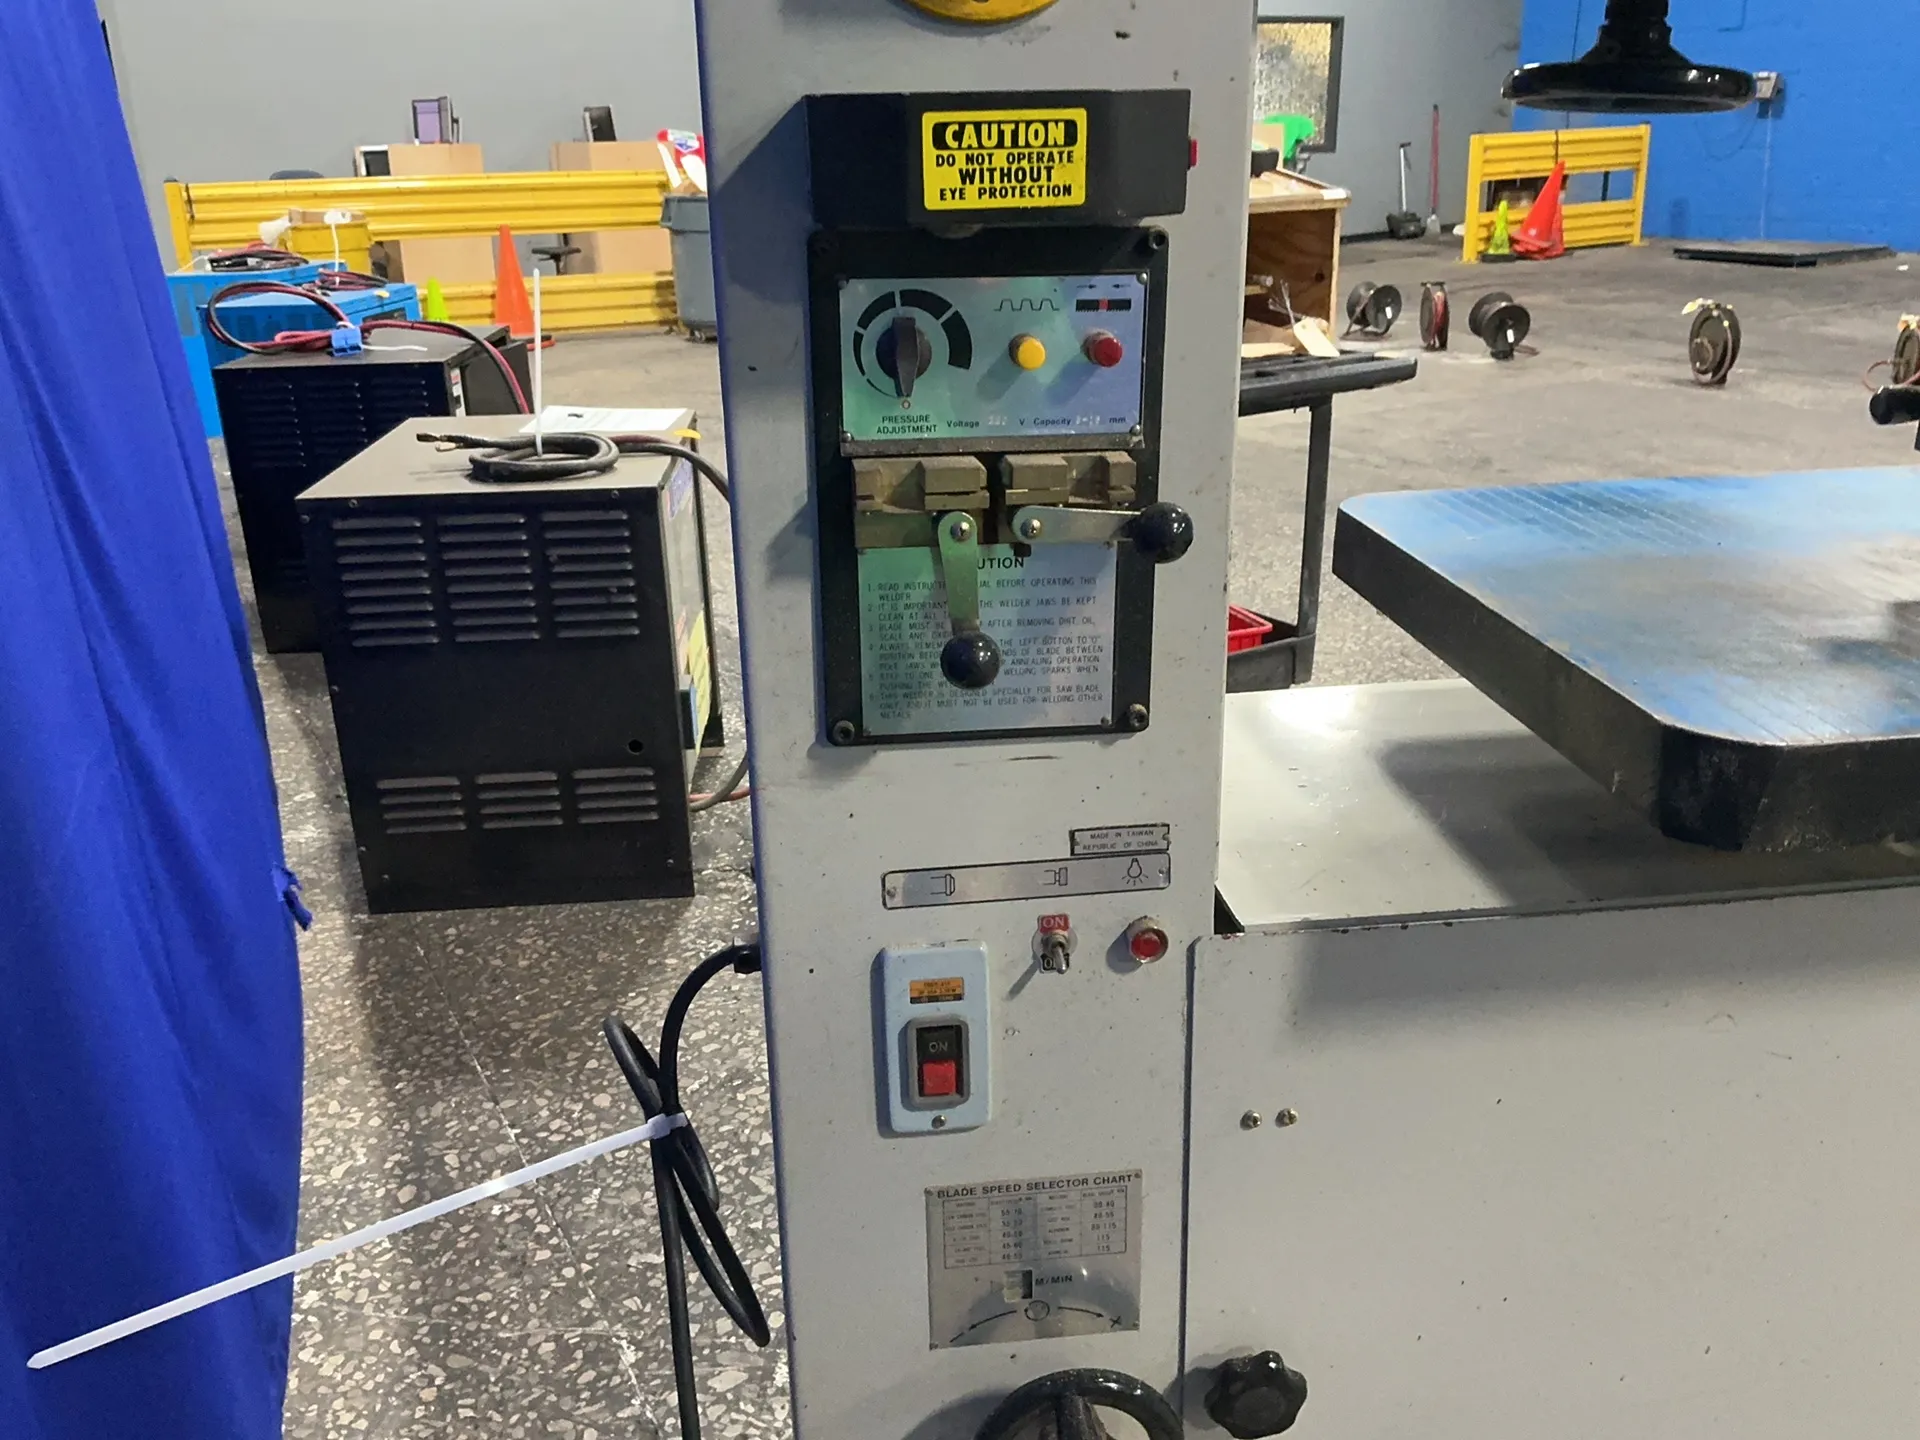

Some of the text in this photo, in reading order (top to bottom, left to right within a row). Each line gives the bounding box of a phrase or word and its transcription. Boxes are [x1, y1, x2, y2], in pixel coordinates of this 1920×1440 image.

[945, 121, 1065, 149] CAUTION
[936, 150, 1074, 167] DO NOT OPERATE
[959, 166, 1054, 185] WITHOUT
[940, 184, 1072, 201] EYE PROTECTION
[882, 415, 931, 424] PRESSURE
[947, 419, 980, 428] Voltage
[1033, 417, 1072, 427] Capacity
[876, 425, 937, 434] ADJUSTMENT
[977, 557, 1024, 569] UTION
[878, 583, 899, 591] READ
[997, 579, 1026, 588] BEFORE
[1031, 577, 1074, 587] OPERATING
[1081, 576, 1097, 585] THIS
[1000, 599, 1030, 608] WELDER
[1037, 598, 1056, 606] JAWS
[1061, 597, 1070, 606] BE
[1076, 596, 1096, 605] KEPT
[988, 618, 1012, 627] AFTER
[1016, 617, 1055, 627] REMOVING
[1066, 645, 1103, 655] BETWEEN
[1057, 656, 1100, 666] OPERATION
[1056, 685, 1072, 693] SAW
[1076, 684, 1099, 692] BLADE
[1090, 832, 1109, 840] MADE
[1082, 840, 1159, 851] REPUBLIC OF CHINA
[1043, 916, 1065, 928] ON
[929, 1041, 949, 1053] ON
[937, 1174, 1133, 1199] BLADE SPEED SELECTOR CHART
